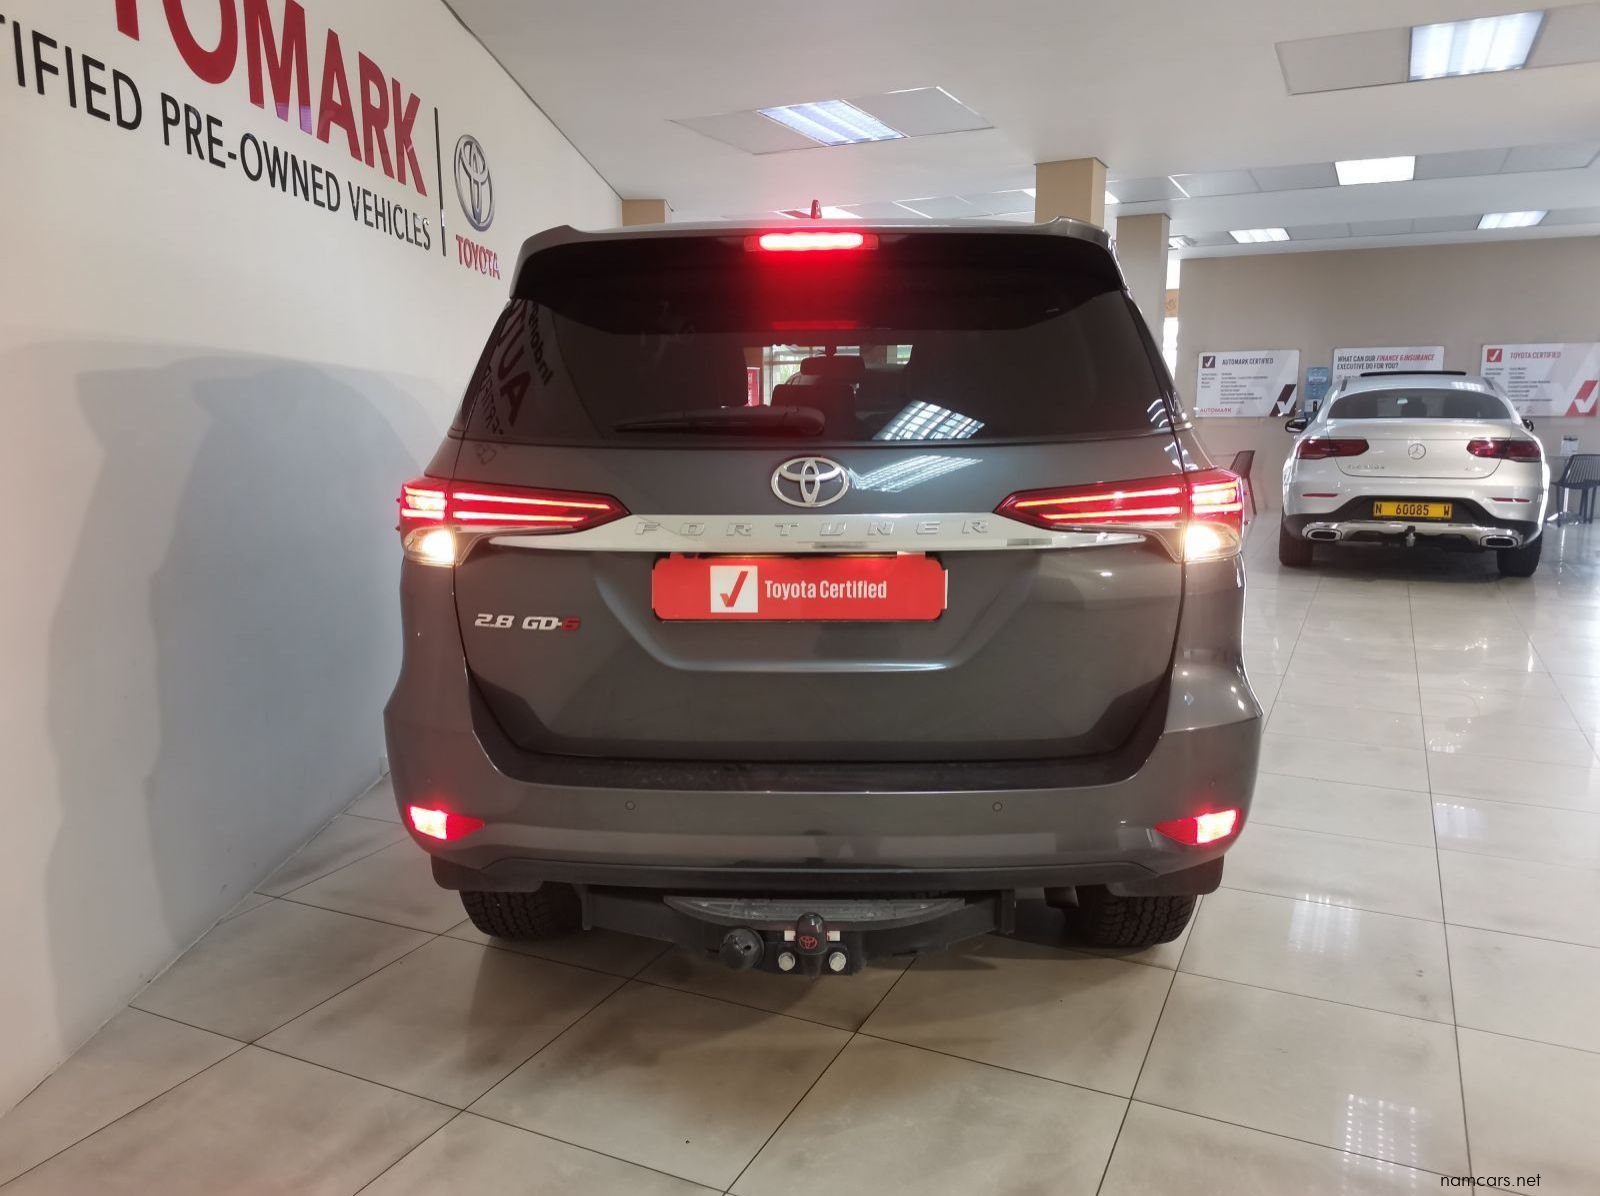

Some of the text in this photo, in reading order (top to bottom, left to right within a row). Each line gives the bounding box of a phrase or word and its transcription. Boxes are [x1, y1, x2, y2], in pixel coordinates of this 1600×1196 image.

[114, 0, 428, 197] OMARK
[0, 14, 431, 250] IFIED PRE-OWNED VEHICLES
[456, 234, 501, 280] TOYOTA
[1249, 357, 1274, 365] CERTIFIED
[1375, 504, 1450, 516] N 60085 W
[634, 519, 989, 537] FORTUNER
[765, 580, 887, 600] Toyota Certified
[474, 613, 580, 631] 2.8 GD-6
